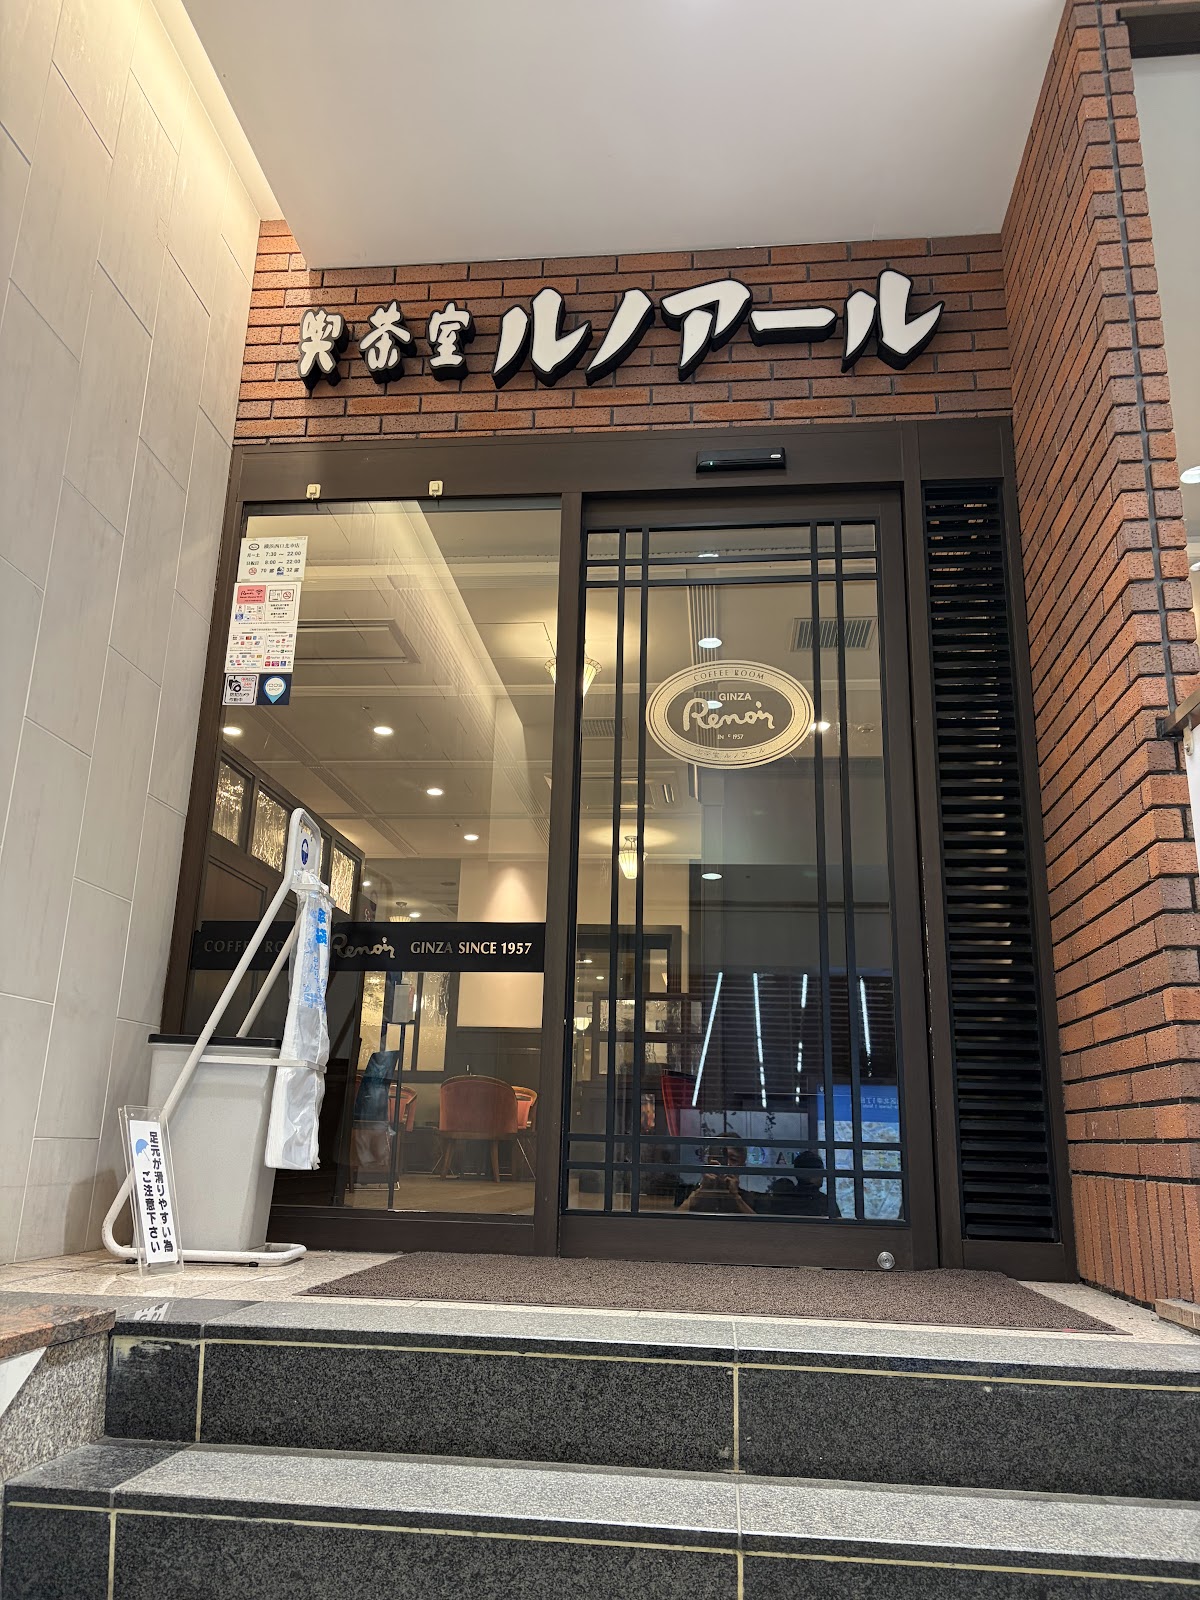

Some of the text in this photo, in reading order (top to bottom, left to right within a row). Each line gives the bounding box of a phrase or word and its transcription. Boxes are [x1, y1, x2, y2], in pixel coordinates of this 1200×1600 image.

[693, 669, 765, 681] COFFEE ROOM
[718, 692, 752, 701] GINZA
[682, 697, 776, 731] Renoir
[203, 940, 248, 953] COFF
[410, 941, 453, 954] GINZA
[458, 941, 497, 954] SINCE
[501, 941, 533, 954] 1957
[149, 1131, 174, 1253] 足元が滑りやすい為
[142, 1170, 161, 1253] ご注意下さい
